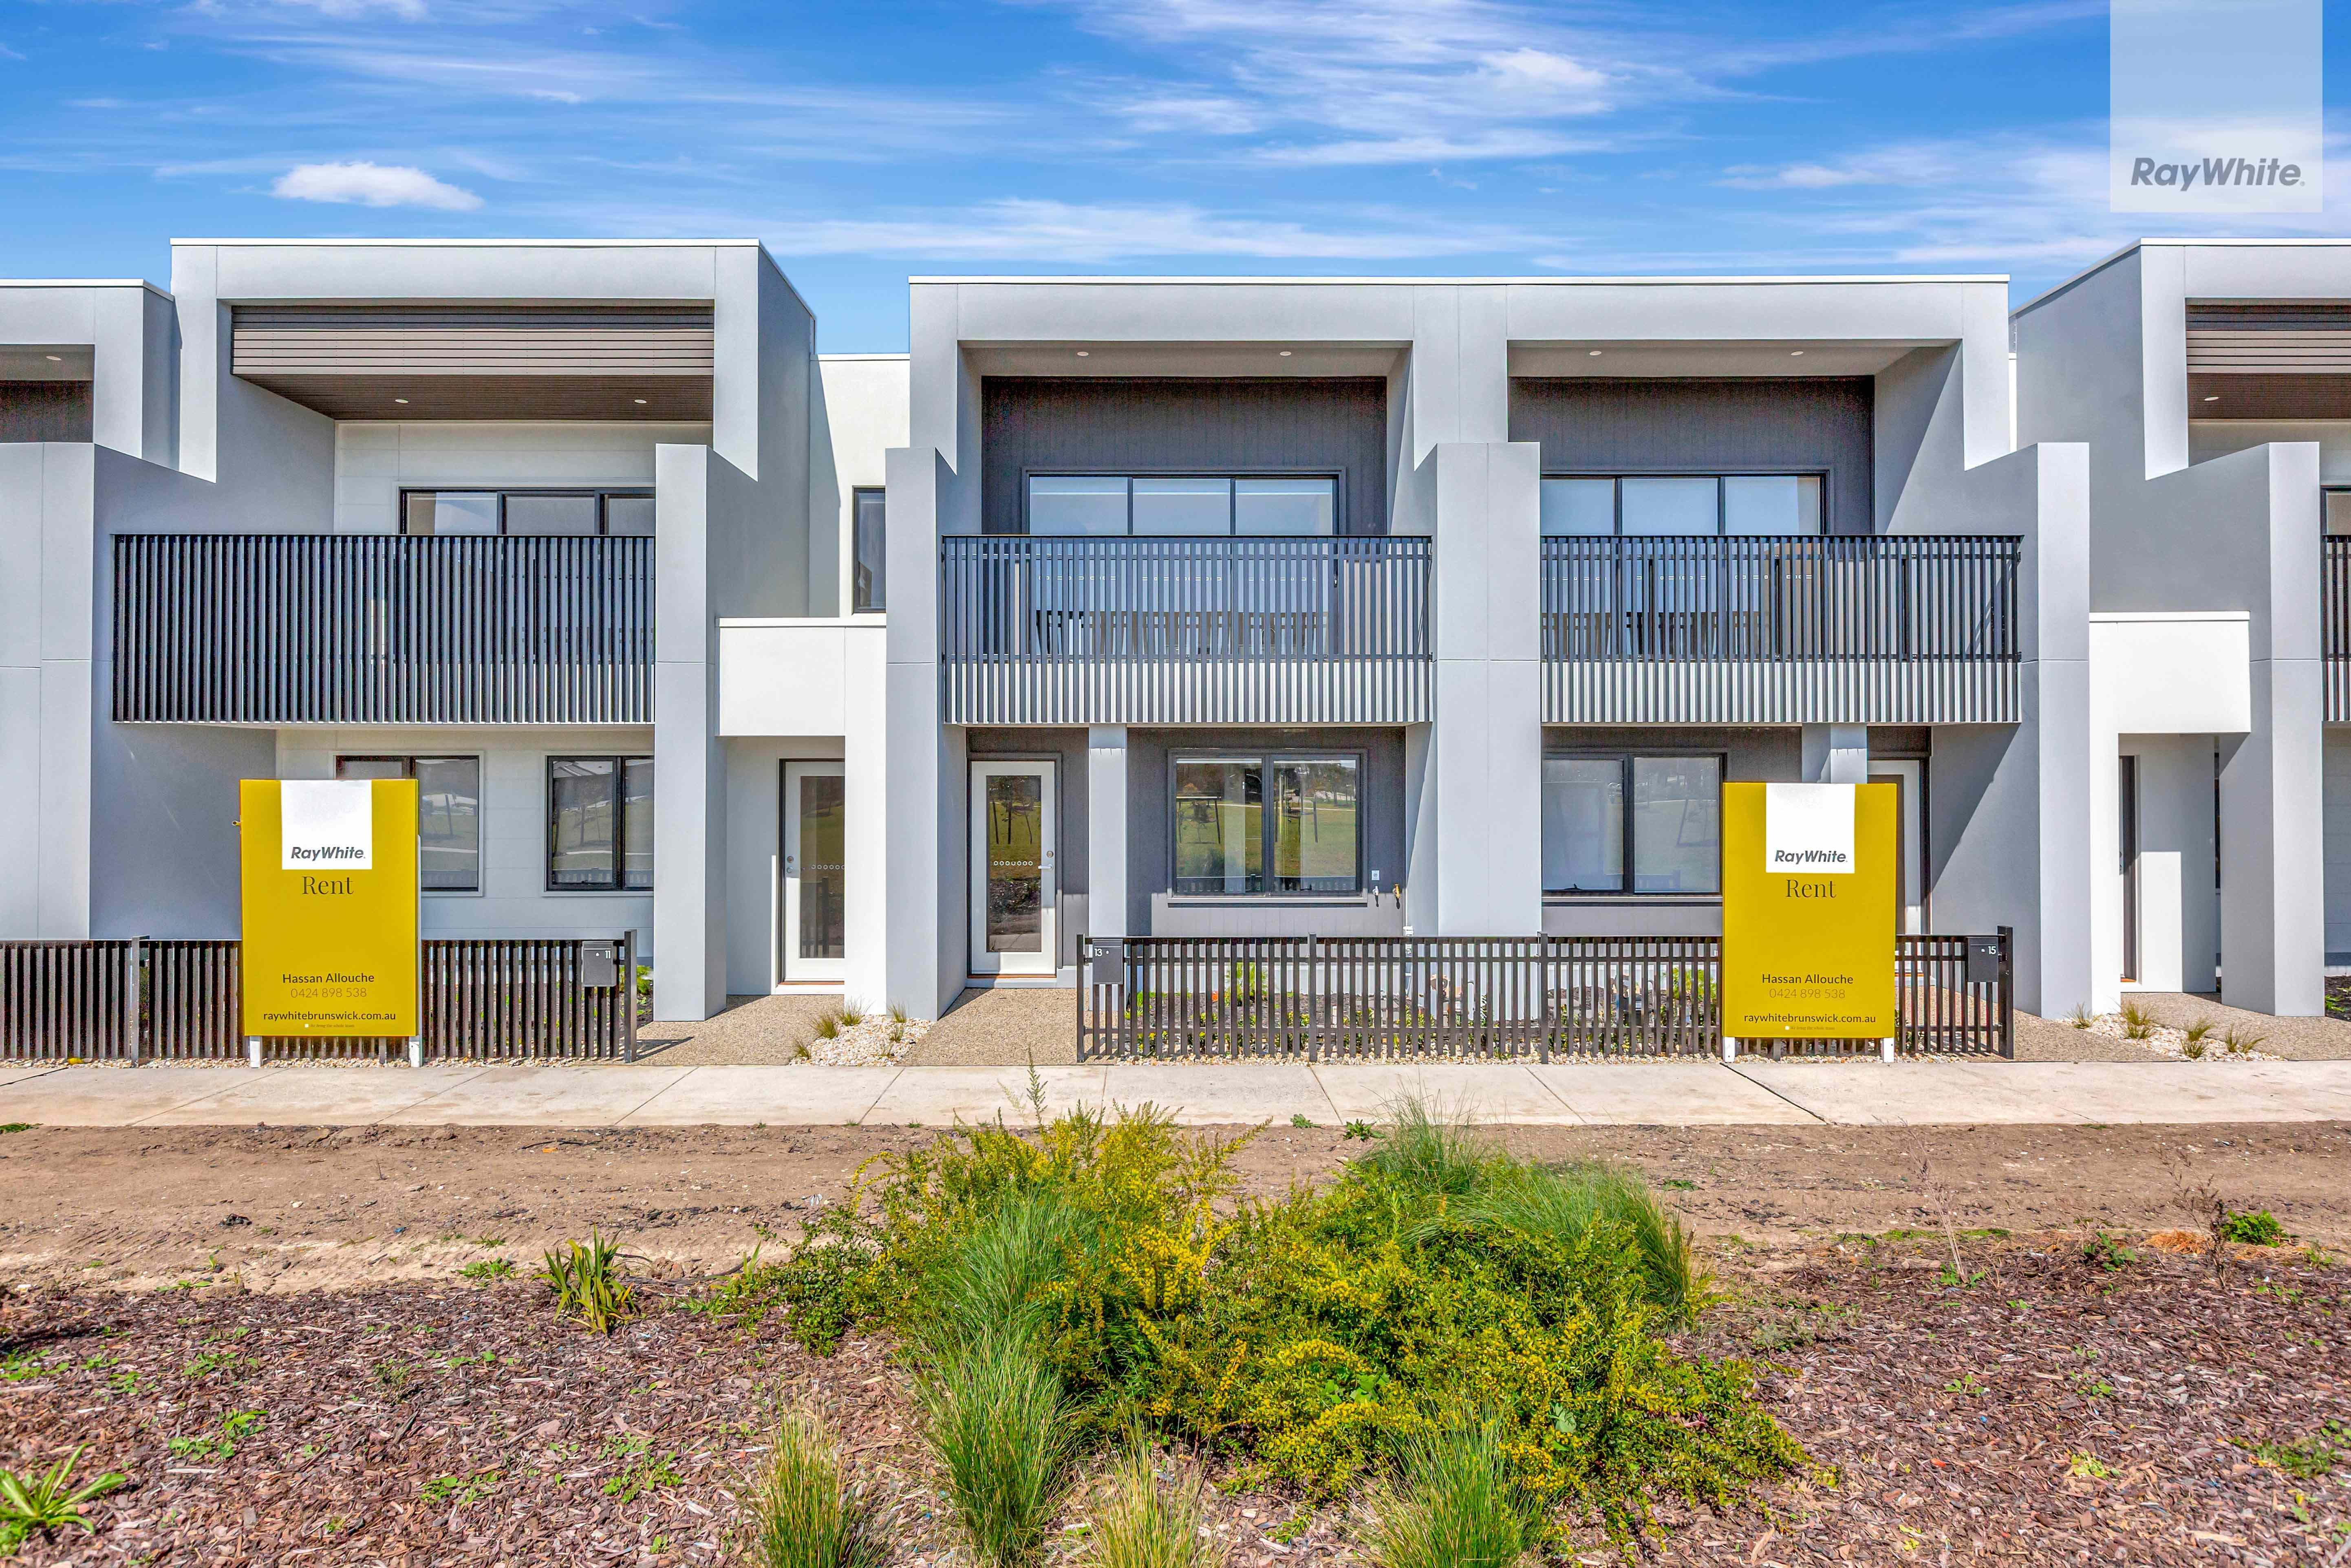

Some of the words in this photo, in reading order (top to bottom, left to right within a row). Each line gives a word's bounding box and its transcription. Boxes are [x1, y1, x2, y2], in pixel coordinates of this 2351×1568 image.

[302, 876, 354, 895] Rent
[1786, 879, 1837, 898] Rent
[605, 950, 611, 959] 11
[1094, 948, 1103, 956] 13
[1988, 946, 1996, 954] 15
[282, 974, 322, 983] Hassan
[326, 973, 375, 983] Allouche
[1762, 974, 1802, 984] Hassan
[1804, 974, 1853, 984] Allouche
[291, 988, 318, 998] 0424
[322, 988, 342, 998] 898
[346, 987, 367, 998] 538
[1769, 988, 1797, 998] 0424
[1800, 988, 1821, 998] 898
[1824, 989, 1845, 999] 538
[264, 1011, 396, 1022] raywhitebrunswick.com.au
[1744, 1013, 1876, 1024] raywhitebrunswick.com.au
